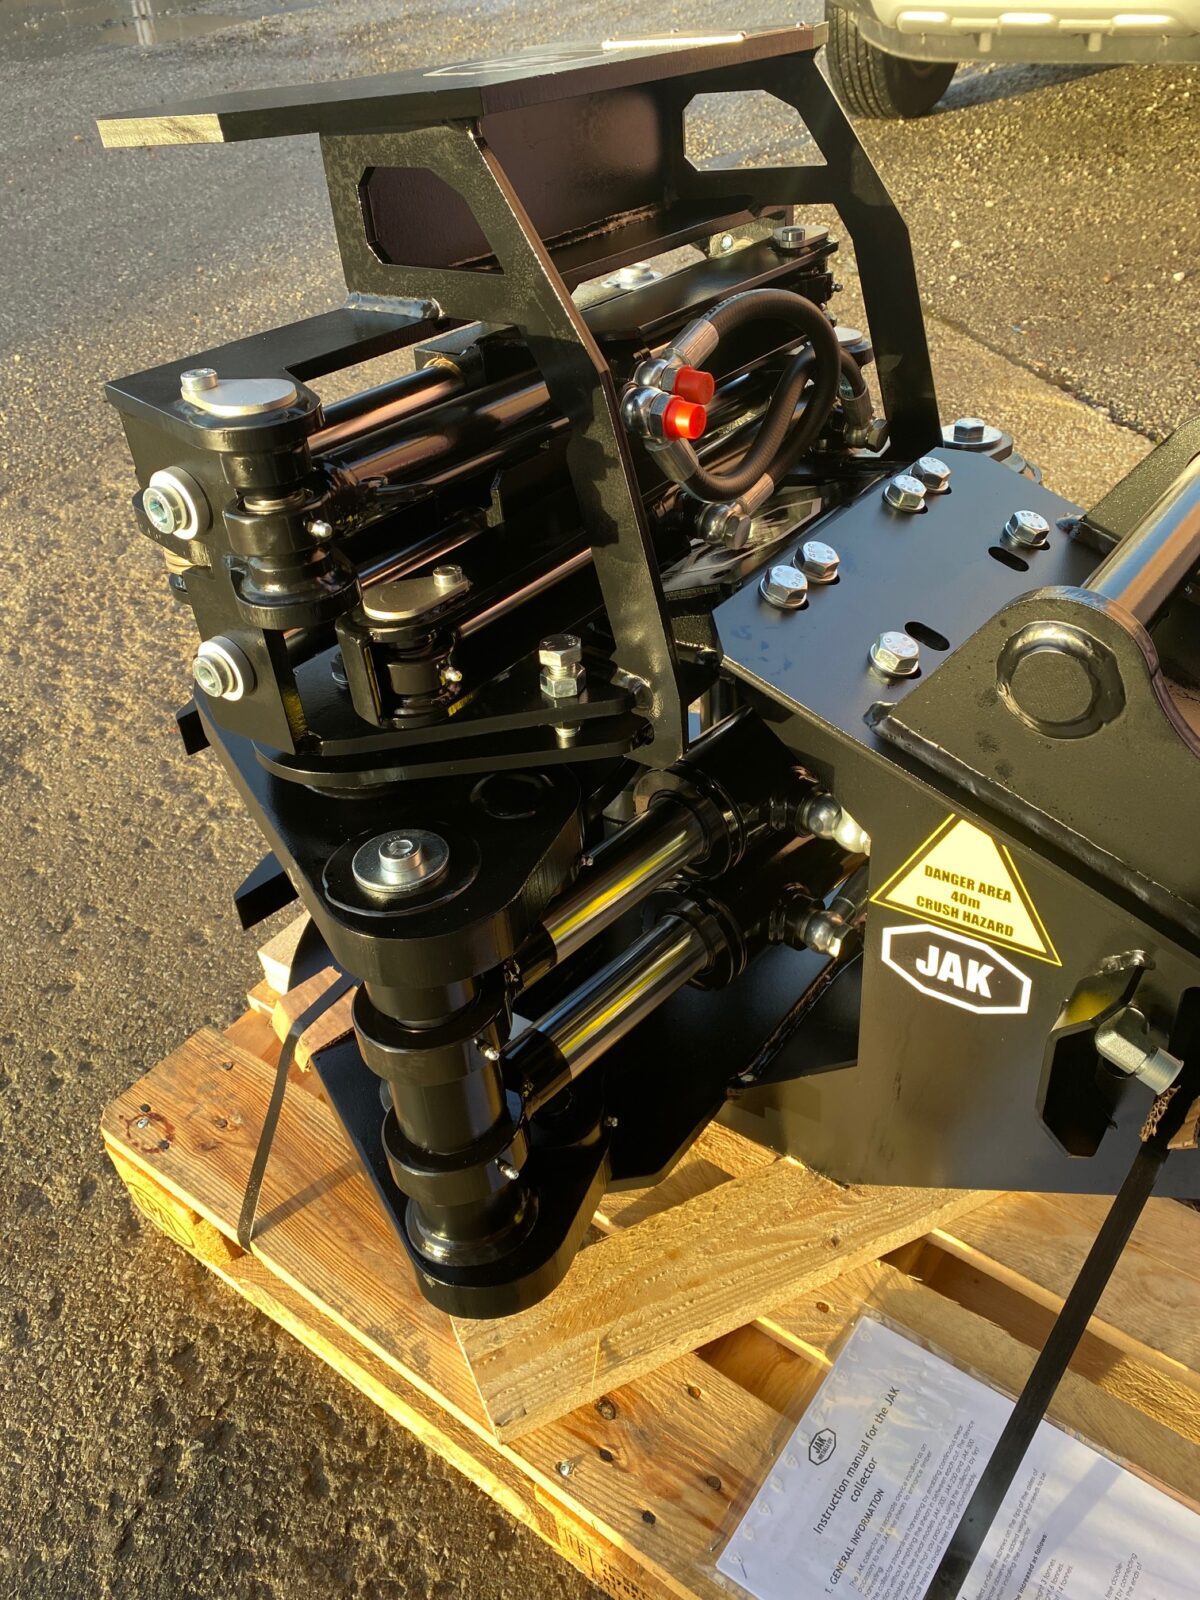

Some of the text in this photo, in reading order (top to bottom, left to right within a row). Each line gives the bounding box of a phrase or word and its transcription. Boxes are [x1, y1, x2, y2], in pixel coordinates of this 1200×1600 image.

[925, 865, 1012, 903] DANGER AREA
[950, 891, 981, 910] 40m
[916, 896, 1014, 937] CRUSH HAZARD
[916, 945, 995, 999] JAK
[812, 1435, 826, 1453] JAK
[952, 1424, 963, 1440] shear
[812, 1385, 899, 1534] Instruction manual for the JAK
[937, 1439, 956, 1469] continuous
[848, 1456, 877, 1502] collector
[925, 1468, 942, 1495] enabling
[1031, 1467, 1039, 1476] of
[855, 1563, 864, 1575] JAK
[861, 1536, 878, 1564] collector
[880, 1500, 898, 1528] separate
[893, 1480, 907, 1501] device
[903, 1457, 919, 1481] installed
[916, 1451, 923, 1459] as
[920, 1443, 927, 1451] an
[887, 1564, 902, 1587] without
[898, 1535, 918, 1566] emptying
[913, 1525, 922, 1536] the
[918, 1507, 931, 1526] shears
[930, 1475, 947, 1502] between
[943, 1460, 954, 1476] each
[961, 1419, 974, 1439] device
[921, 1494, 930, 1503] by
[1017, 1499, 1024, 1508] of
[1020, 1489, 1029, 1501] the
[857, 1562, 876, 1593] accessory
[871, 1553, 879, 1562] to
[875, 1542, 885, 1555] the
[881, 1531, 890, 1543] JAK
[893, 1500, 906, 1519] shears
[902, 1493, 910, 1501] to
[906, 1468, 923, 1494] enhance
[919, 1449, 932, 1469] timber
[901, 1569, 910, 1580] for
[906, 1557, 916, 1571] tree
[912, 1540, 924, 1558] shear
[921, 1518, 935, 1541] models
[954, 1460, 964, 1473] and
[903, 1563, 923, 1594] important
[918, 1551, 928, 1564] that
[925, 1539, 935, 1552] you
[930, 1513, 947, 1540] practice
[942, 1498, 955, 1515] using
[950, 1488, 959, 1499] the
[955, 1463, 971, 1489] collector
[967, 1455, 976, 1465] by
[906, 1502, 926, 1533] harvesting
[1007, 1518, 1016, 1529] the
[824, 1488, 884, 1593] 1. GENERAL INFORMATION
[890, 1531, 909, 1564] streamlines
[918, 1569, 929, 1585] trees
[925, 1561, 932, 1570] to
[929, 1544, 941, 1562] avoid
[937, 1529, 948, 1544] trees
[944, 1511, 958, 1531] falling
[996, 1538, 1007, 1558] screws
[1005, 1529, 1011, 1538] on
[1011, 1550, 1020, 1561] the
[1119, 1551, 1138, 1588] connecting
[876, 1563, 893, 1591] collector
[980, 1568, 993, 1588] under
[1017, 1563, 1034, 1593] increased
[1032, 1555, 1038, 1564] as
